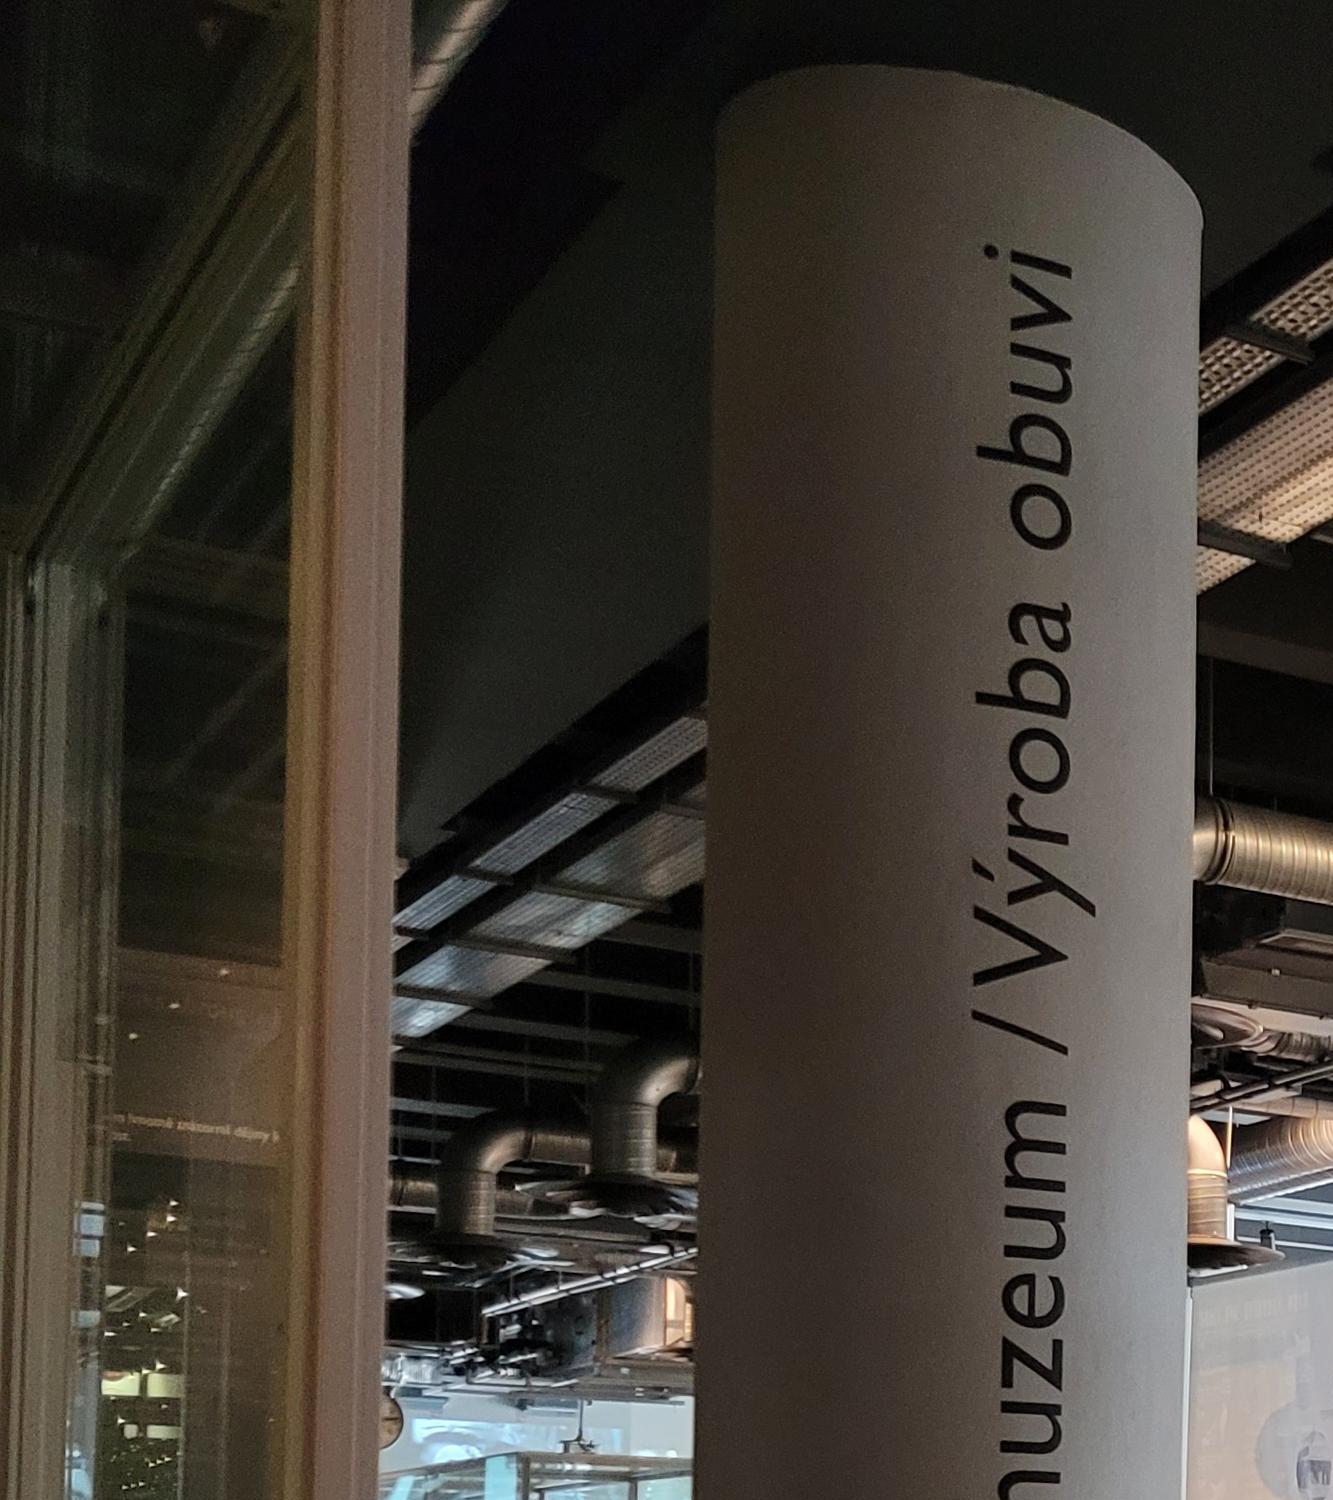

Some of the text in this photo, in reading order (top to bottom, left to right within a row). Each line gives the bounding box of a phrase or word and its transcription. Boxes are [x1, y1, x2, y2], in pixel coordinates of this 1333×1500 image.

[975, 244, 1072, 551] obuvi
[972, 601, 1097, 987] Výroba
[970, 1009, 1068, 1057] /
